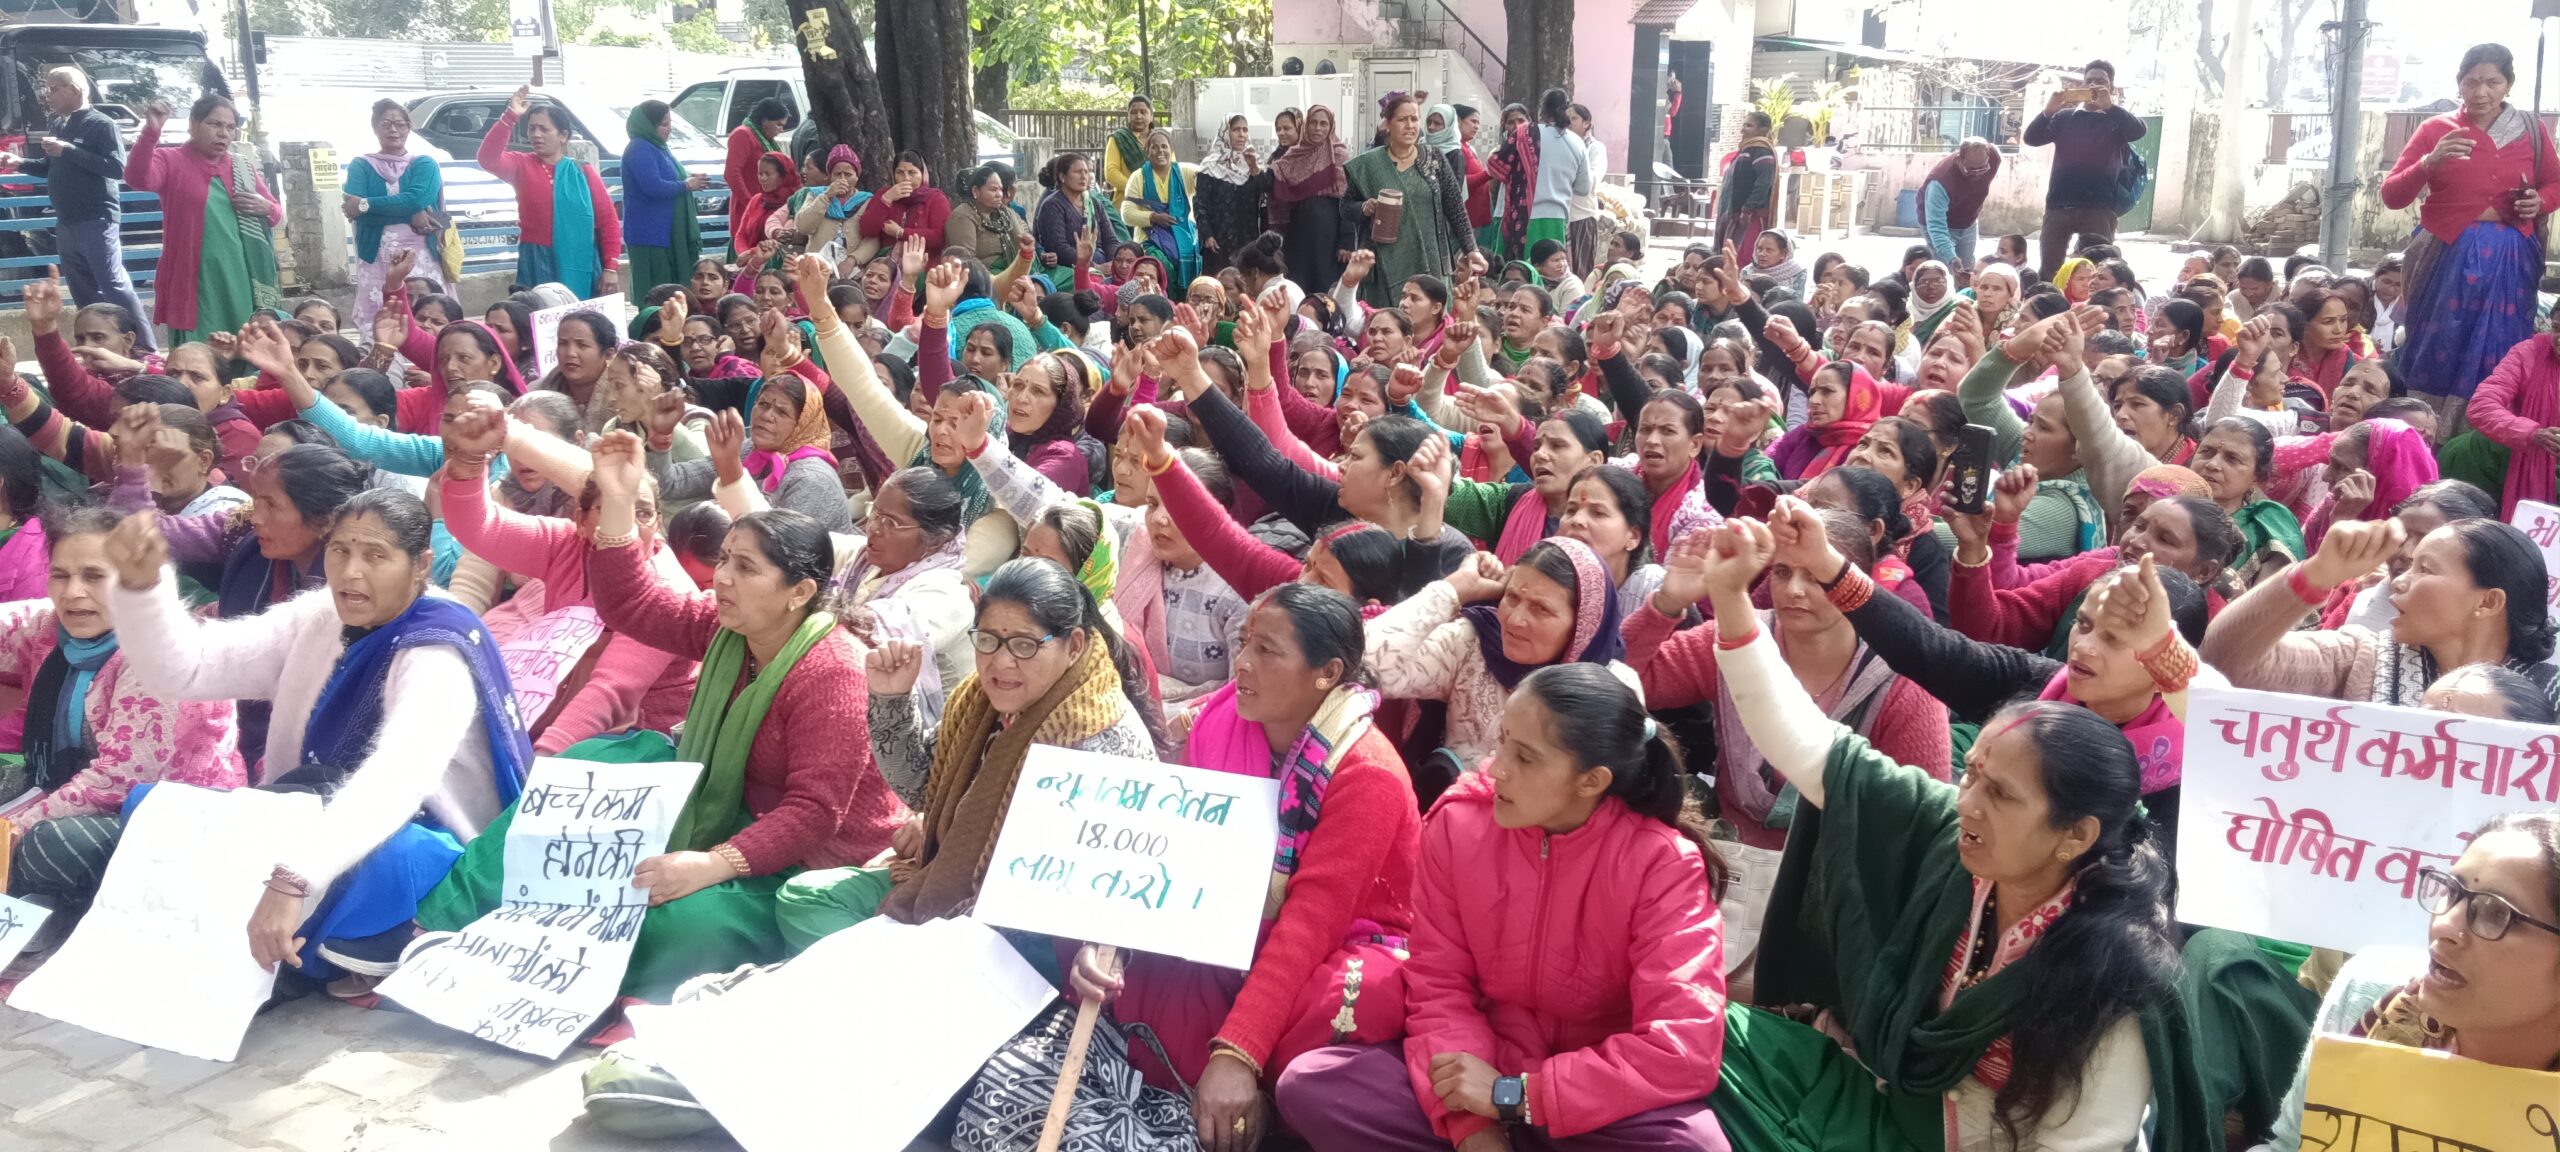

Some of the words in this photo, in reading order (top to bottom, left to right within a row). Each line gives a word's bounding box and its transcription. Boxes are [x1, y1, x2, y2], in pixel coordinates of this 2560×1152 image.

[2210, 706, 2360, 782] चतुर्थ
[2356, 719, 2560, 803] कर्मचारी
[592, 785, 660, 821] कम
[599, 829, 645, 880] की
[2222, 797, 2376, 882] घोषित
